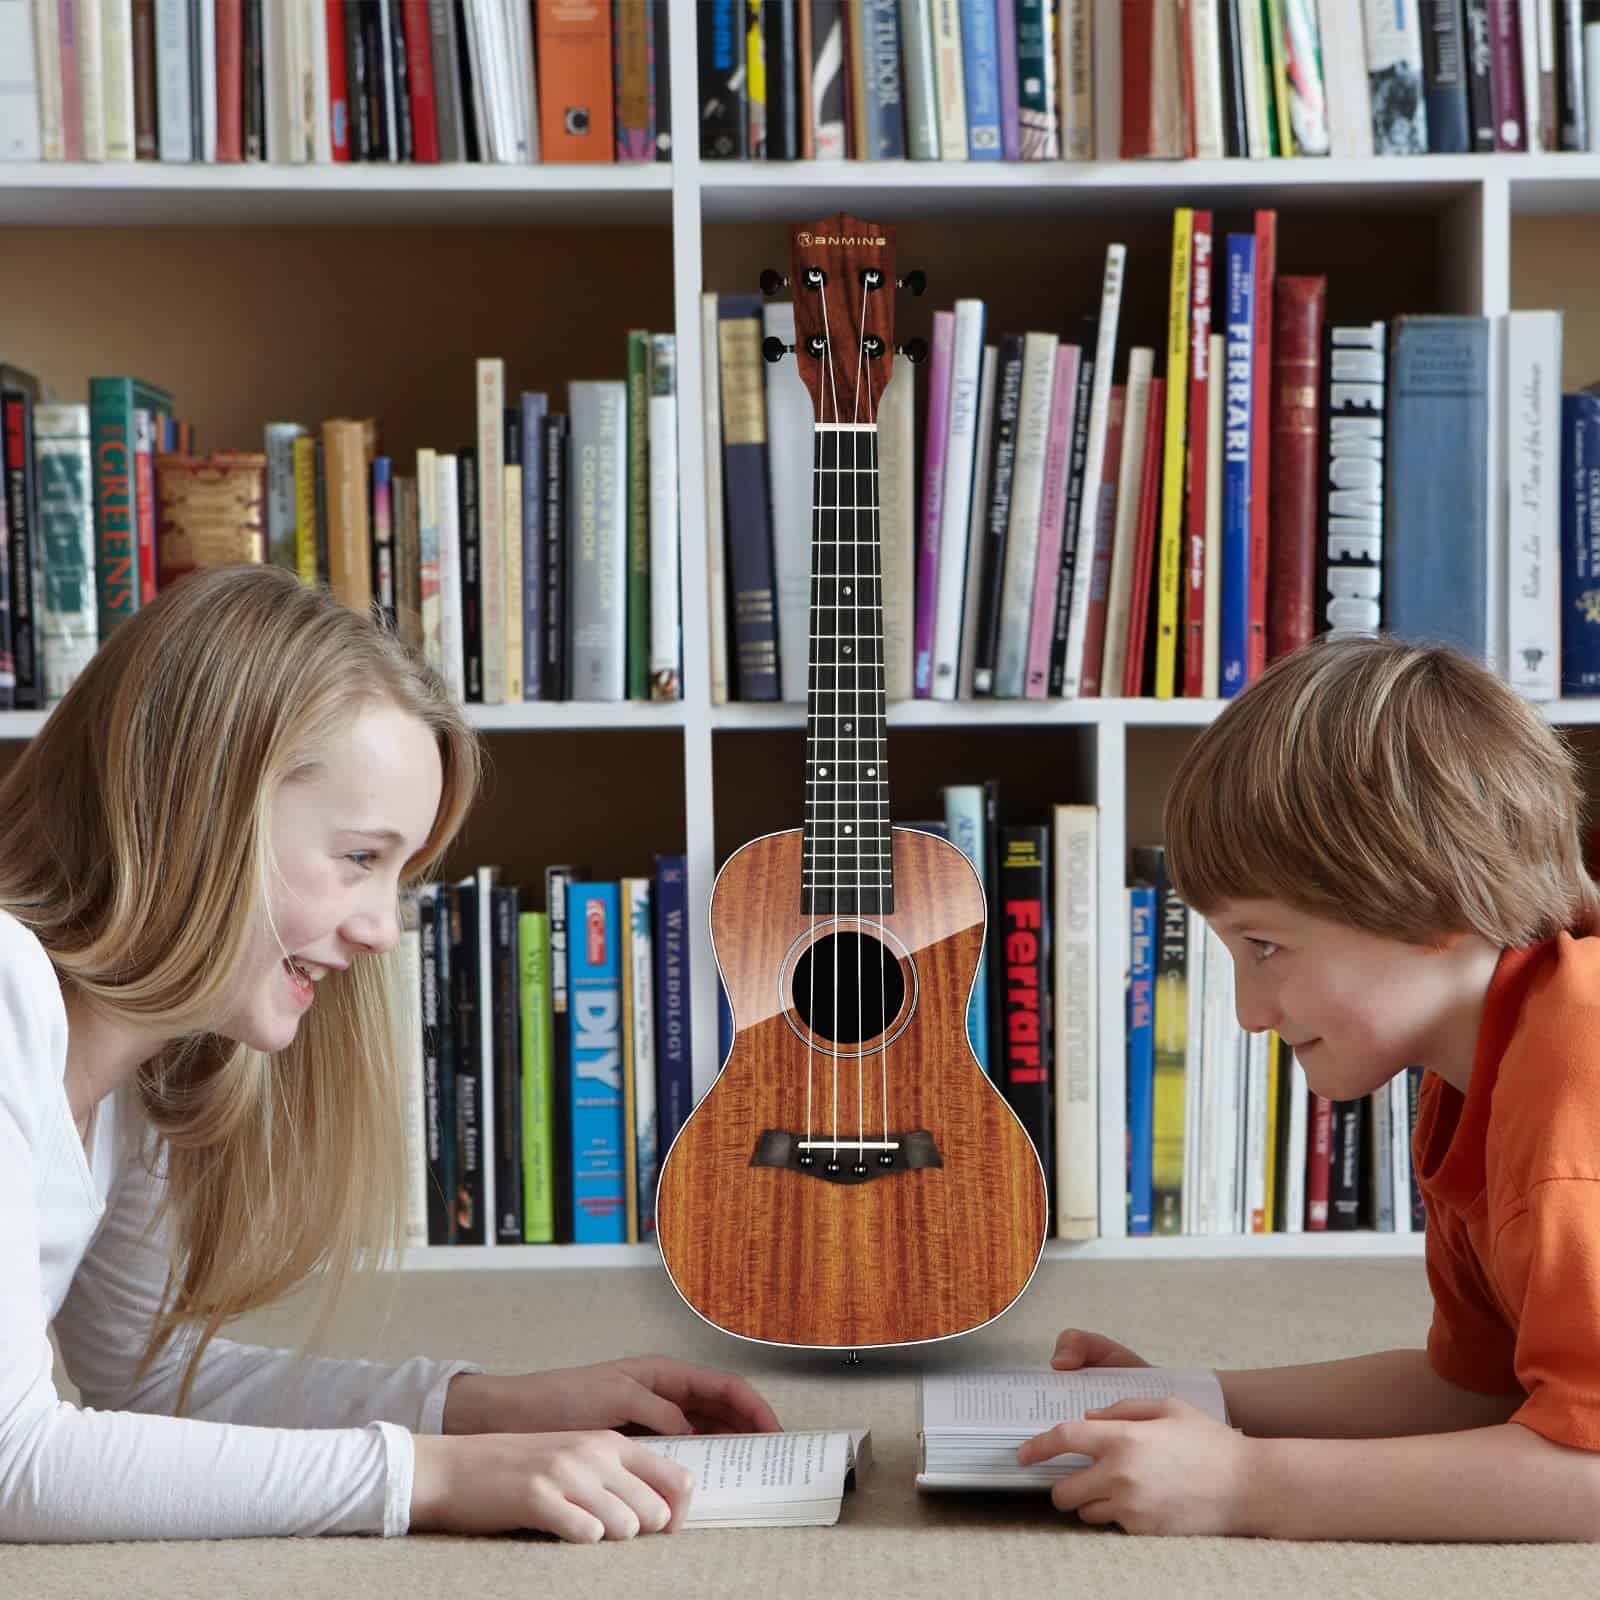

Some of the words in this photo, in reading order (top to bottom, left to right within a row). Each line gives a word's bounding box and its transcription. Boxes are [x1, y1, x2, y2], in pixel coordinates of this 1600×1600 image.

[1227, 322, 1249, 462] FERRARI
[1330, 321, 1386, 410] THE
[98, 441, 132, 608] GREENS
[1327, 416, 1383, 561] MOVIE
[574, 989, 621, 1089] DIY
[666, 909, 682, 1062] WIZARDOLOGY
[1005, 899, 1048, 1084] Ferrari
